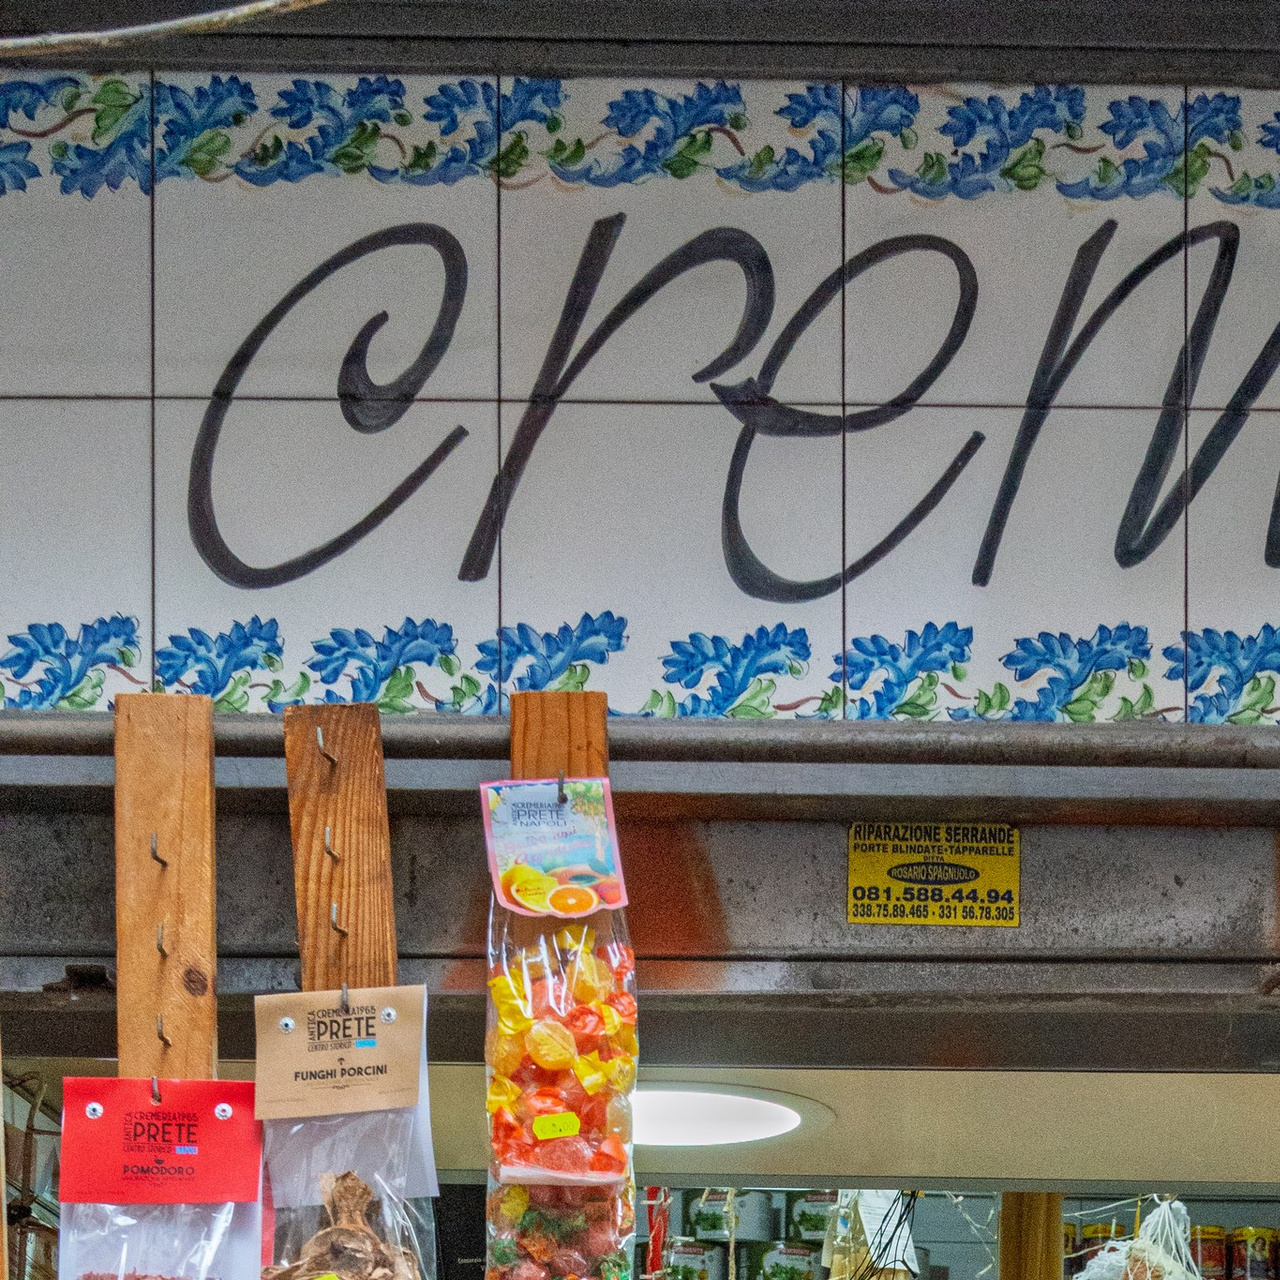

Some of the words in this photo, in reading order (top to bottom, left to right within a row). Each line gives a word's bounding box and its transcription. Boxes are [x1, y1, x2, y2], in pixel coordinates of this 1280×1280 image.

[517, 809, 565, 821] PRETE
[853, 824, 941, 842] RIPARAZIONE
[945, 826, 1014, 844] SERRANDE
[853, 843, 889, 853] PORTE
[891, 865, 927, 880] ROSARIO
[928, 866, 976, 881] SPAGNUOLO
[852, 886, 1014, 904] 081.588.44.94
[852, 903, 929, 919] 338.75.89.465
[938, 904, 957, 920] 331
[962, 906, 1015, 921] 56.78.305
[317, 1016, 376, 1041] PRETE
[294, 1069, 337, 1082] FUNGHI
[340, 1064, 388, 1078] PORCINI
[133, 1122, 198, 1144] PRETE
[123, 1165, 195, 1176] POMODORO
